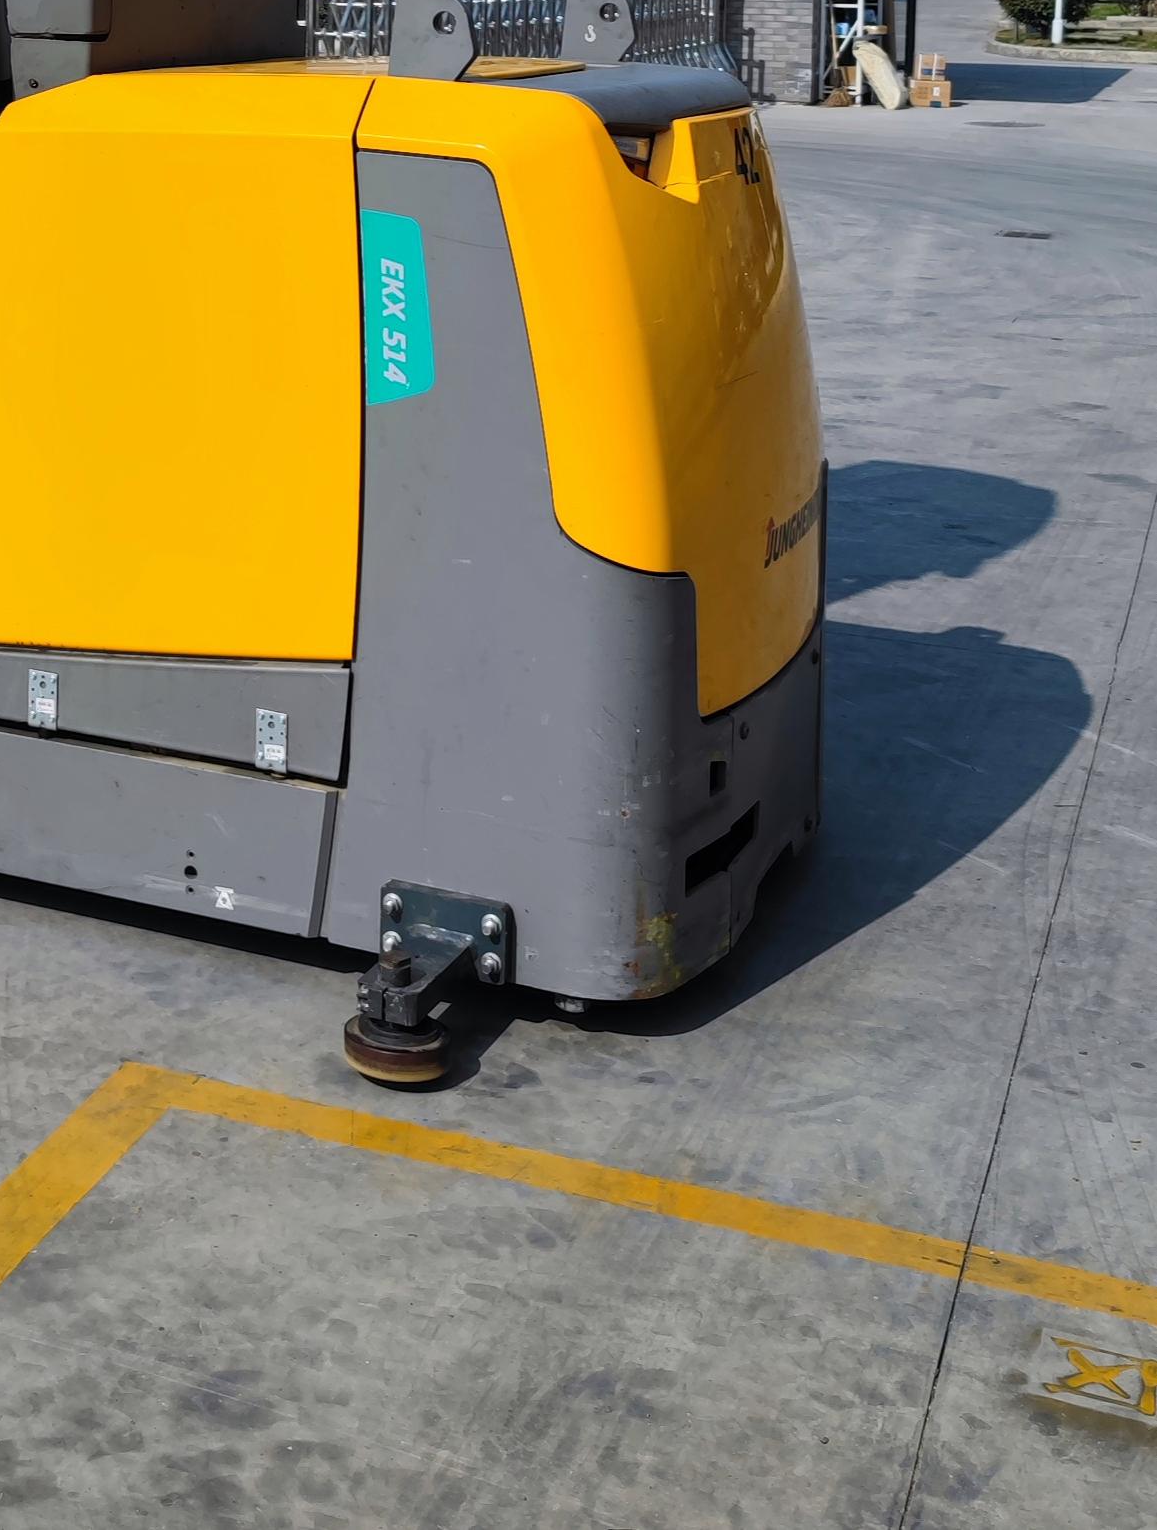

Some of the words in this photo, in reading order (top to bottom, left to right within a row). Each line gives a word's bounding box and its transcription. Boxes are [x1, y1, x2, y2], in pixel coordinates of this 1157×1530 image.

[734, 127, 760, 185] 42
[380, 258, 406, 322] EKX
[382, 327, 408, 386] 514
